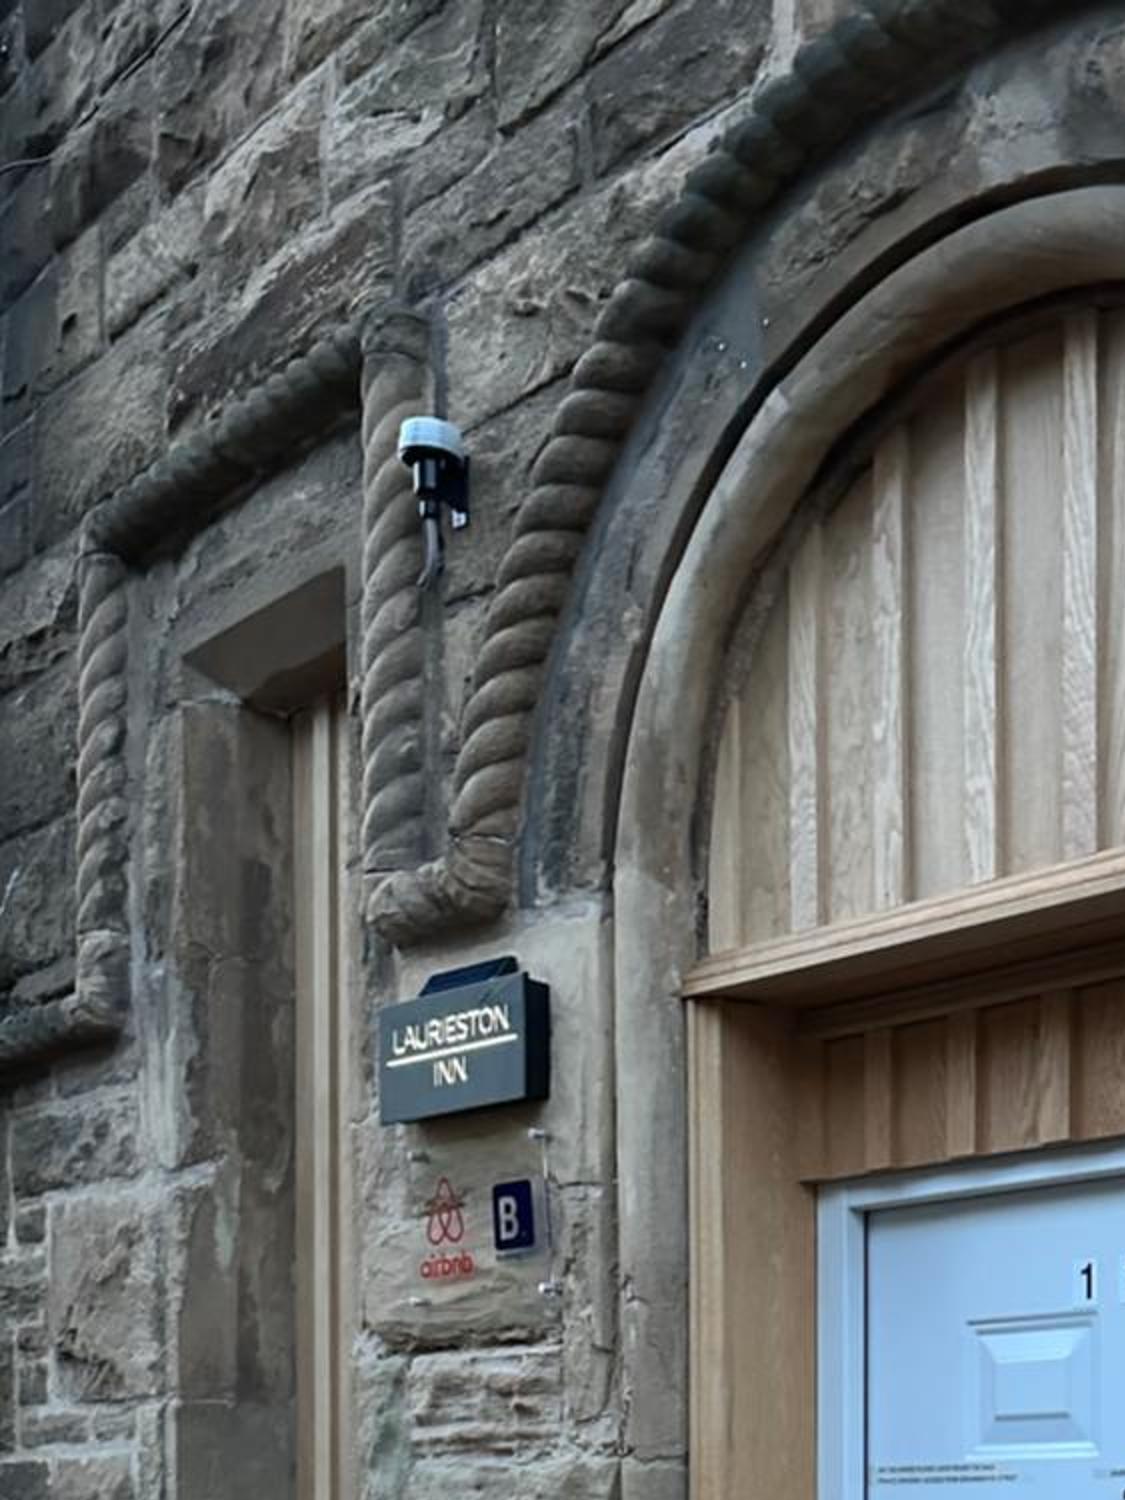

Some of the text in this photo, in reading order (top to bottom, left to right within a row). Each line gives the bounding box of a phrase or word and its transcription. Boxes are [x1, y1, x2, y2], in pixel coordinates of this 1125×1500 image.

[392, 1006, 509, 1054] LAURIESTON
[433, 1056, 468, 1087] INN
[420, 1251, 474, 1280] airbnb
